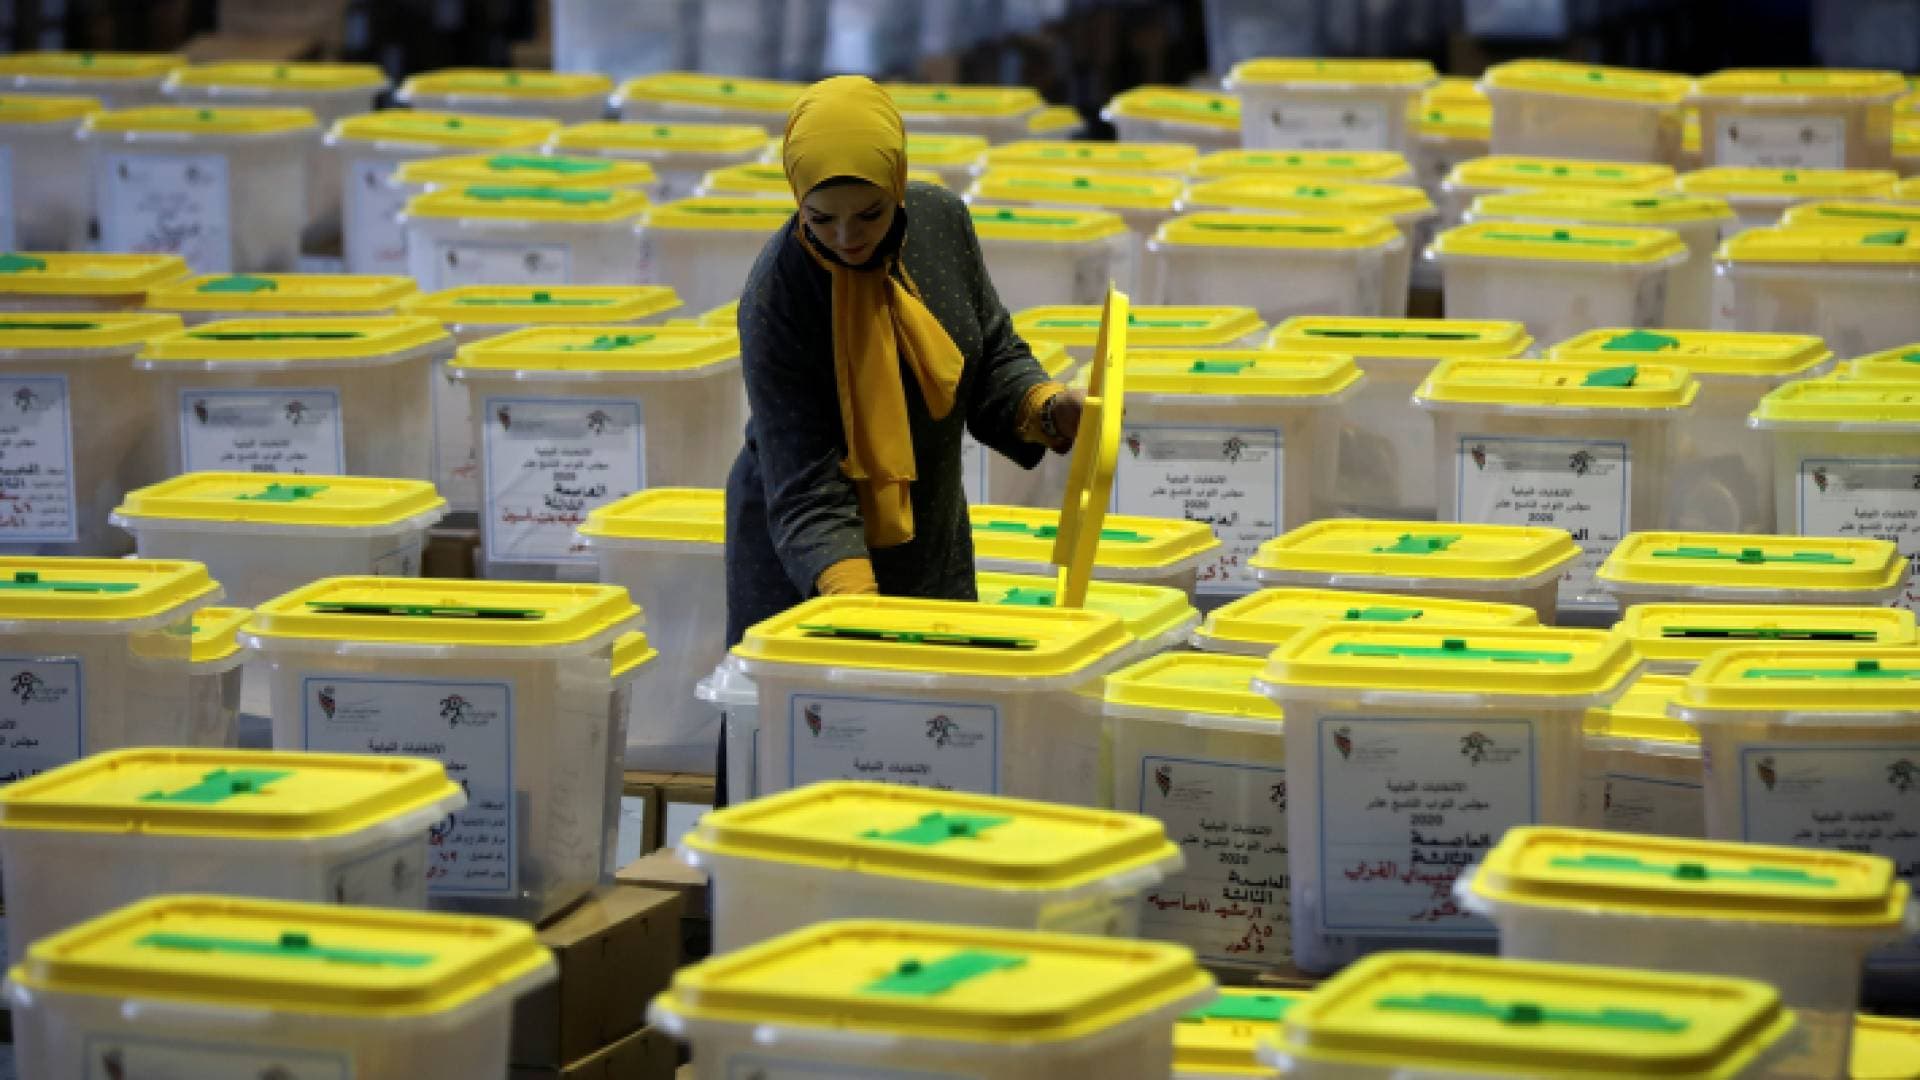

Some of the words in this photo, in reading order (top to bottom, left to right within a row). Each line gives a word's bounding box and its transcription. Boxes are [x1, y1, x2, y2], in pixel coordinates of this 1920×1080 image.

[1410, 814, 1443, 827] 2020
[1410, 829, 1491, 849] العاصمة
[1218, 852, 1249, 865] 2020
[1410, 847, 1474, 866] الثالثة
[1227, 868, 1291, 890] العاصمة
[1222, 886, 1274, 905] الثالثة
